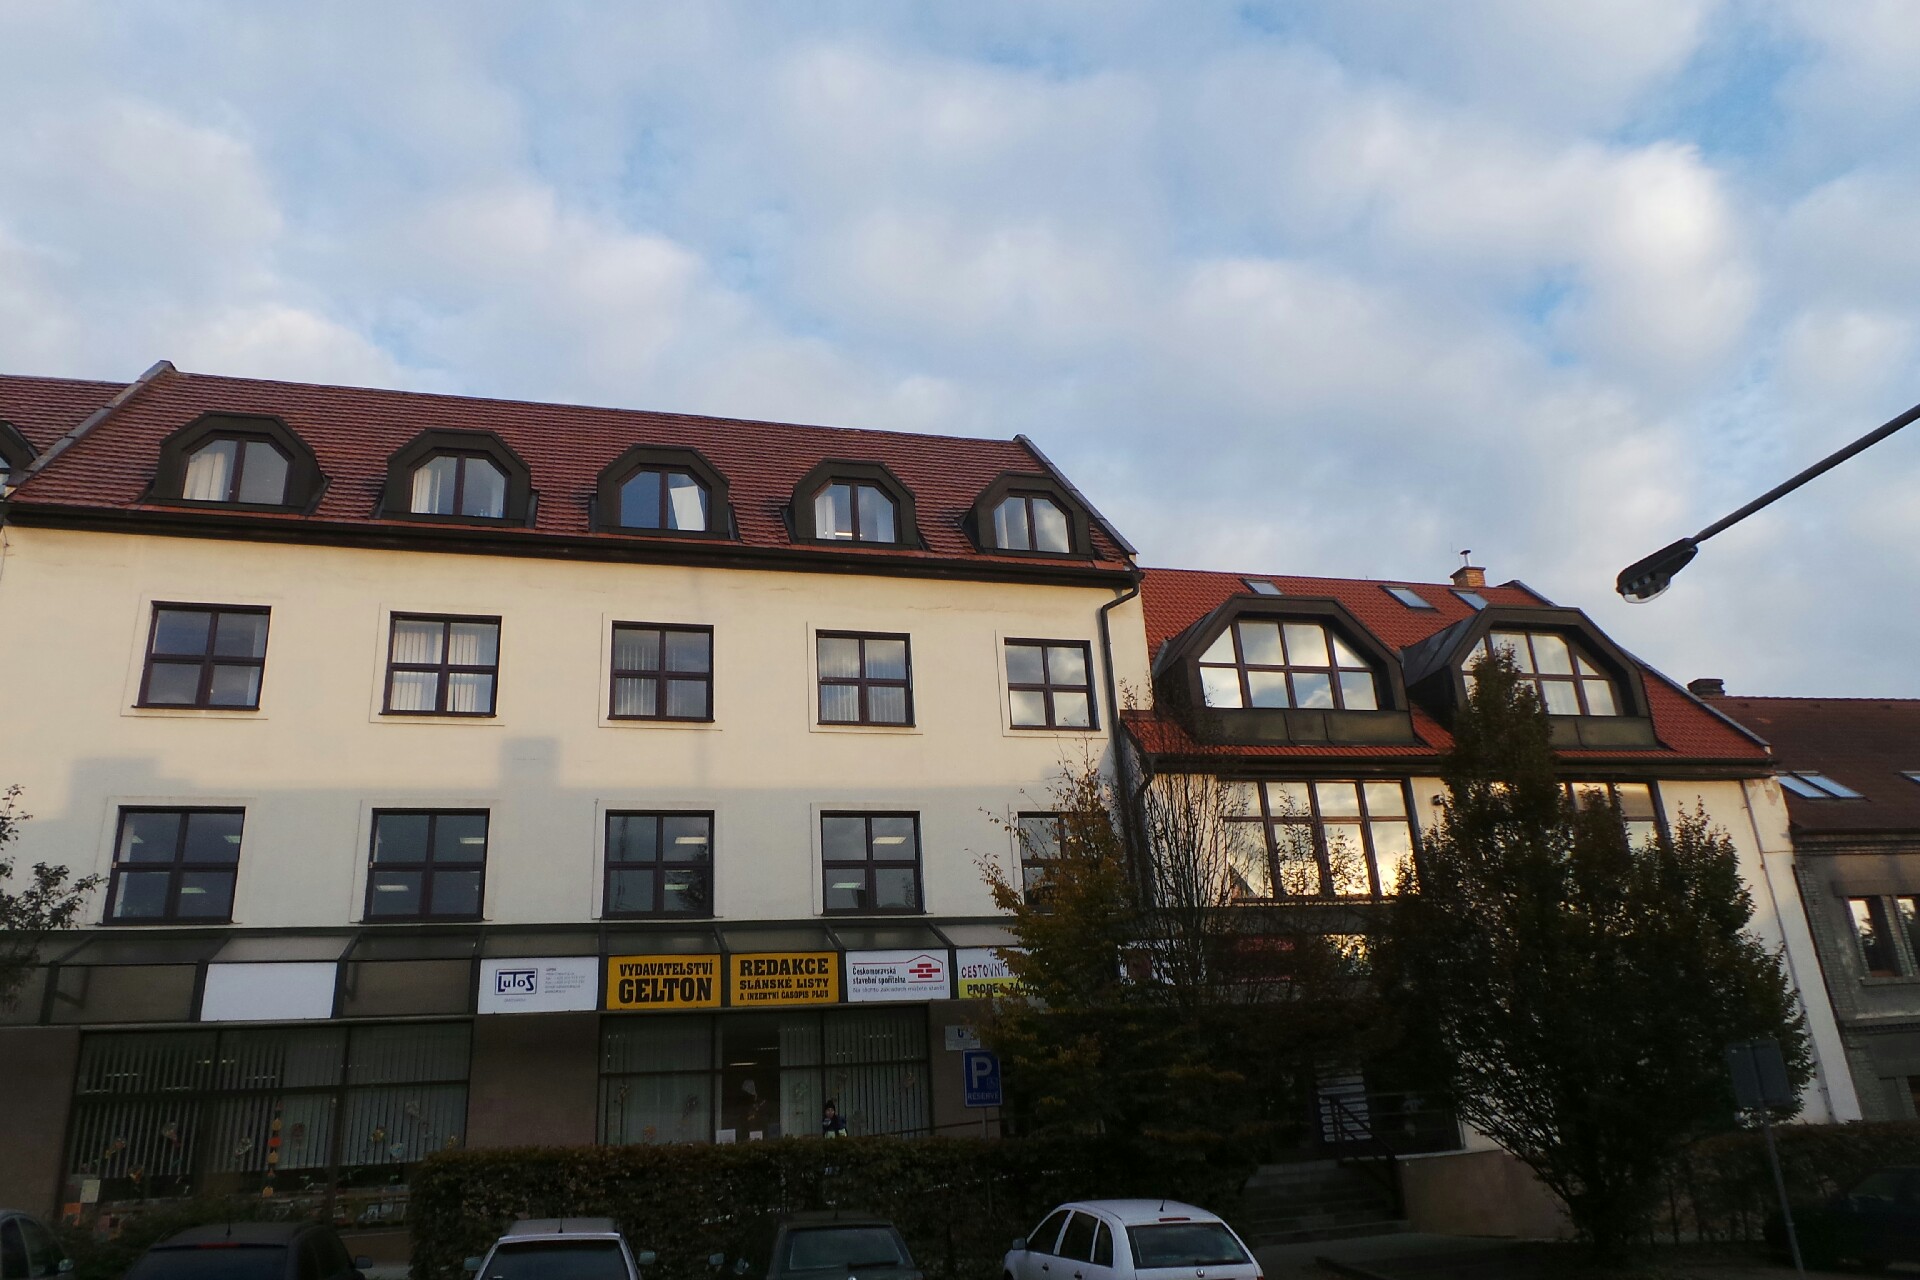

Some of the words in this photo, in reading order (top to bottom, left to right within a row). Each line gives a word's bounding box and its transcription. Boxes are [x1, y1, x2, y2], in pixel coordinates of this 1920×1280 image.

[619, 960, 713, 976] VYDAVATELSTVÍ
[739, 957, 829, 976] REDAKCE
[852, 966, 897, 975] Českomoravská
[740, 977, 792, 990] SLÁNSKÉ
[796, 977, 829, 989] LISTY
[852, 976, 877, 984] stavební
[878, 975, 906, 985] spořitelna
[618, 977, 712, 1003] GELTON
[740, 993, 745, 1001] A
[747, 991, 779, 1000] INZERTNÍ
[781, 989, 810, 999] ČASOPIS
[811, 990, 829, 998] PLUS
[971, 1056, 992, 1089] P
